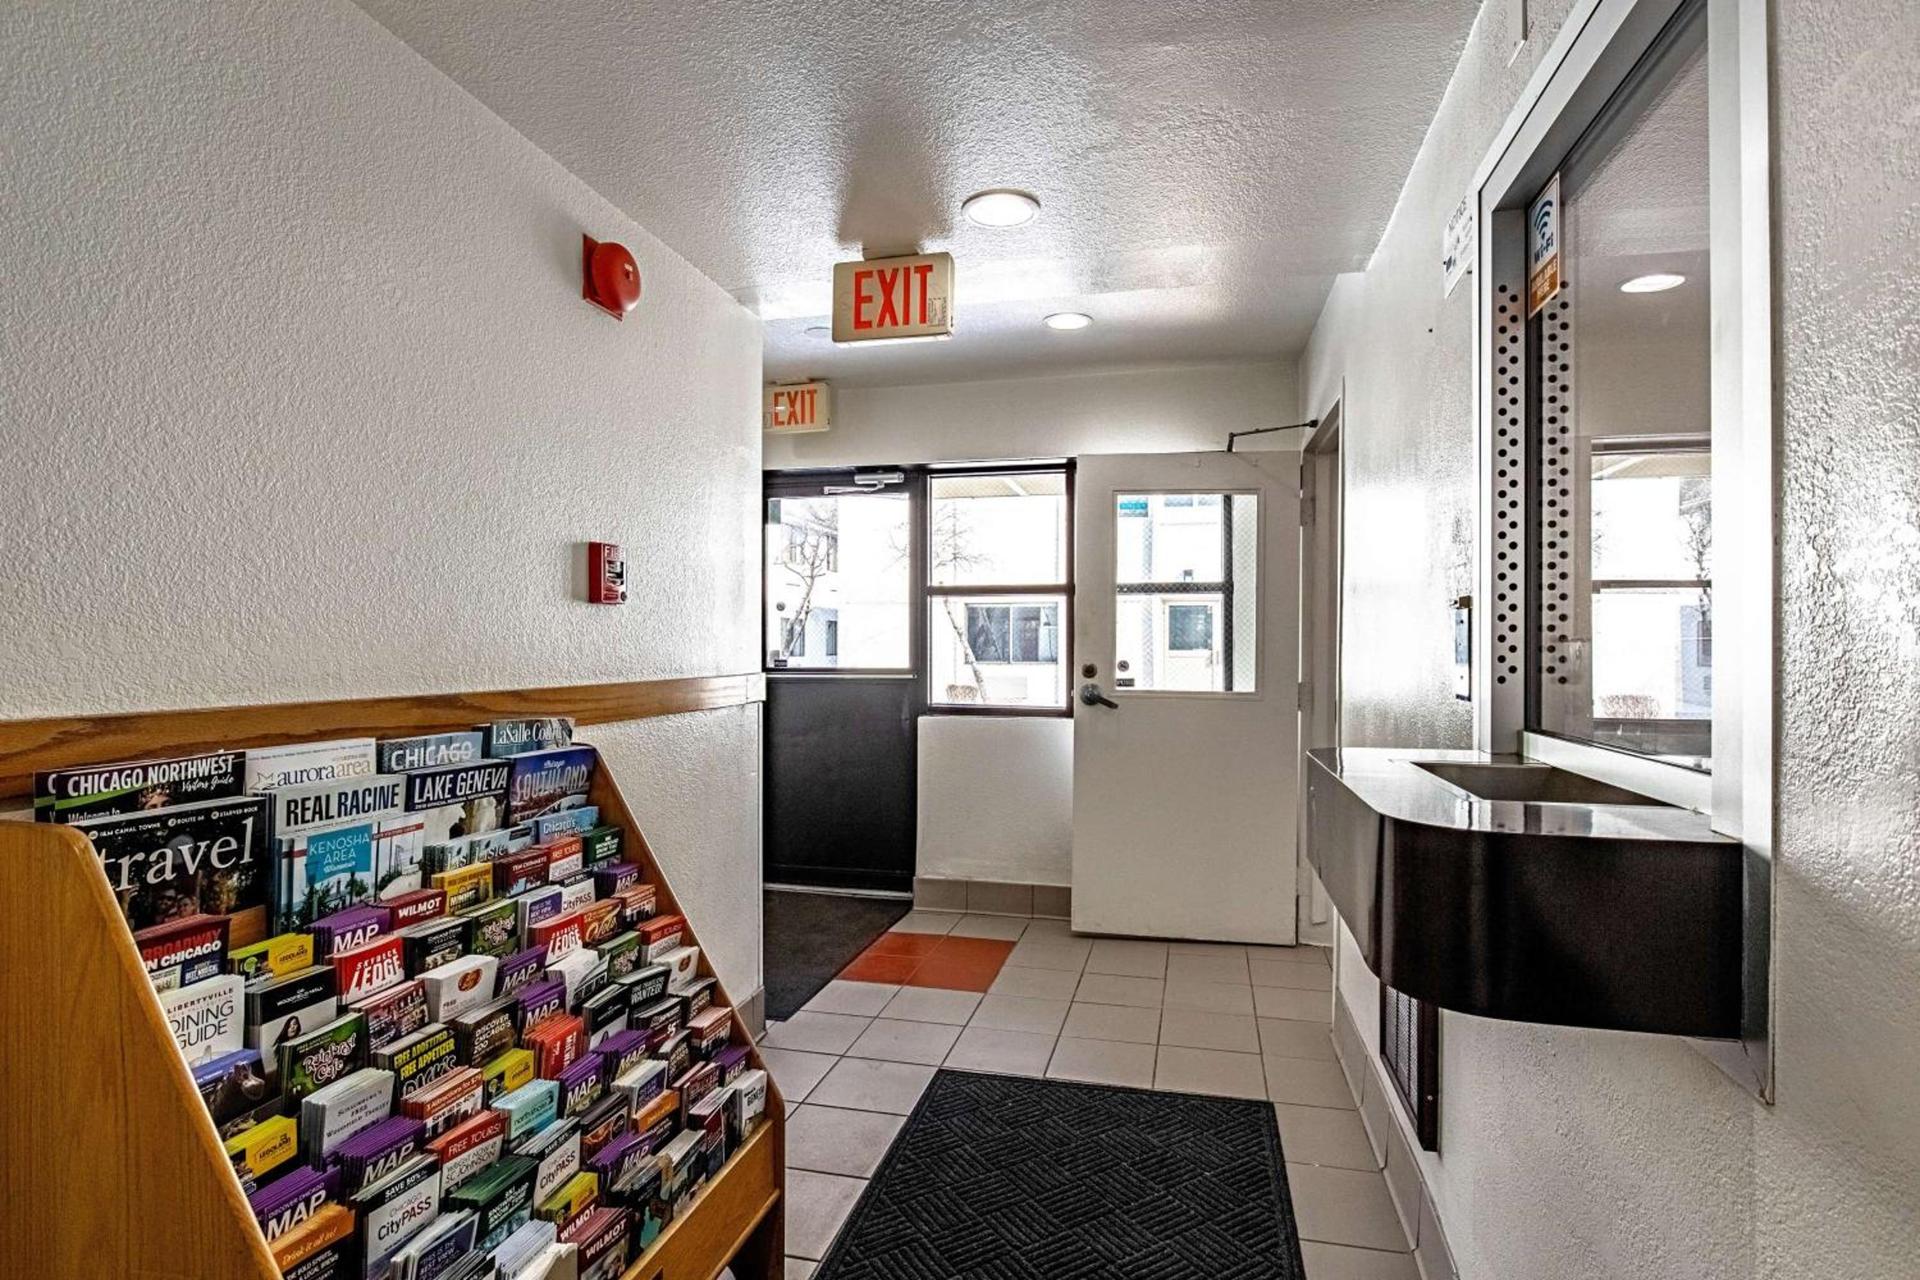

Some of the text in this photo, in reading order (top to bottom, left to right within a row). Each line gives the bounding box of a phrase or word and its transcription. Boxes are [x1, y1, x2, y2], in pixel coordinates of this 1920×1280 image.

[853, 264, 934, 331] EXIT
[773, 388, 818, 427] EXIT
[492, 722, 531, 746] LaSalle
[391, 740, 473, 771] CHICAGO
[67, 767, 144, 797] CHICAGO
[148, 754, 236, 786] NORTHWEST
[276, 764, 336, 788] aurora
[414, 774, 455, 803] LAKE
[456, 766, 509, 796] GENEVA
[516, 764, 588, 802] SOUTHLAND
[285, 794, 335, 827] REAL
[337, 783, 400, 819] RACINE
[99, 816, 254, 892] travel
[309, 832, 370, 857] KENOSHA
[323, 848, 357, 866] AREA
[398, 897, 442, 919] WILMOT
[142, 928, 222, 962] BROADWAY
[160, 940, 222, 968] CHICAGO
[333, 923, 379, 954] MAP
[502, 962, 537, 992] MAP
[167, 987, 234, 1014] LIBERTYVILLE
[169, 1000, 234, 1034] DINING
[525, 998, 560, 1029] MAP
[176, 1018, 229, 1050] GUIDE
[473, 1018, 512, 1046] CHICAGO'S
[475, 1013, 510, 1037] DISCOVER
[394, 1050, 411, 1069] FREE
[400, 1038, 456, 1080] FREE APPETIZER
[617, 1043, 646, 1079] MAP
[565, 1074, 597, 1118] MAP
[448, 1137, 468, 1158] FREE
[620, 1145, 650, 1178] MAP
[362, 1142, 415, 1187] MAP
[539, 1150, 576, 1190] CityPASS
[384, 1181, 406, 1199] SAVE
[266, 1189, 327, 1243] MAP
[378, 1196, 432, 1241] CityPASS
[560, 1203, 596, 1241] WILMOT
[586, 1218, 627, 1260] WILMOT
